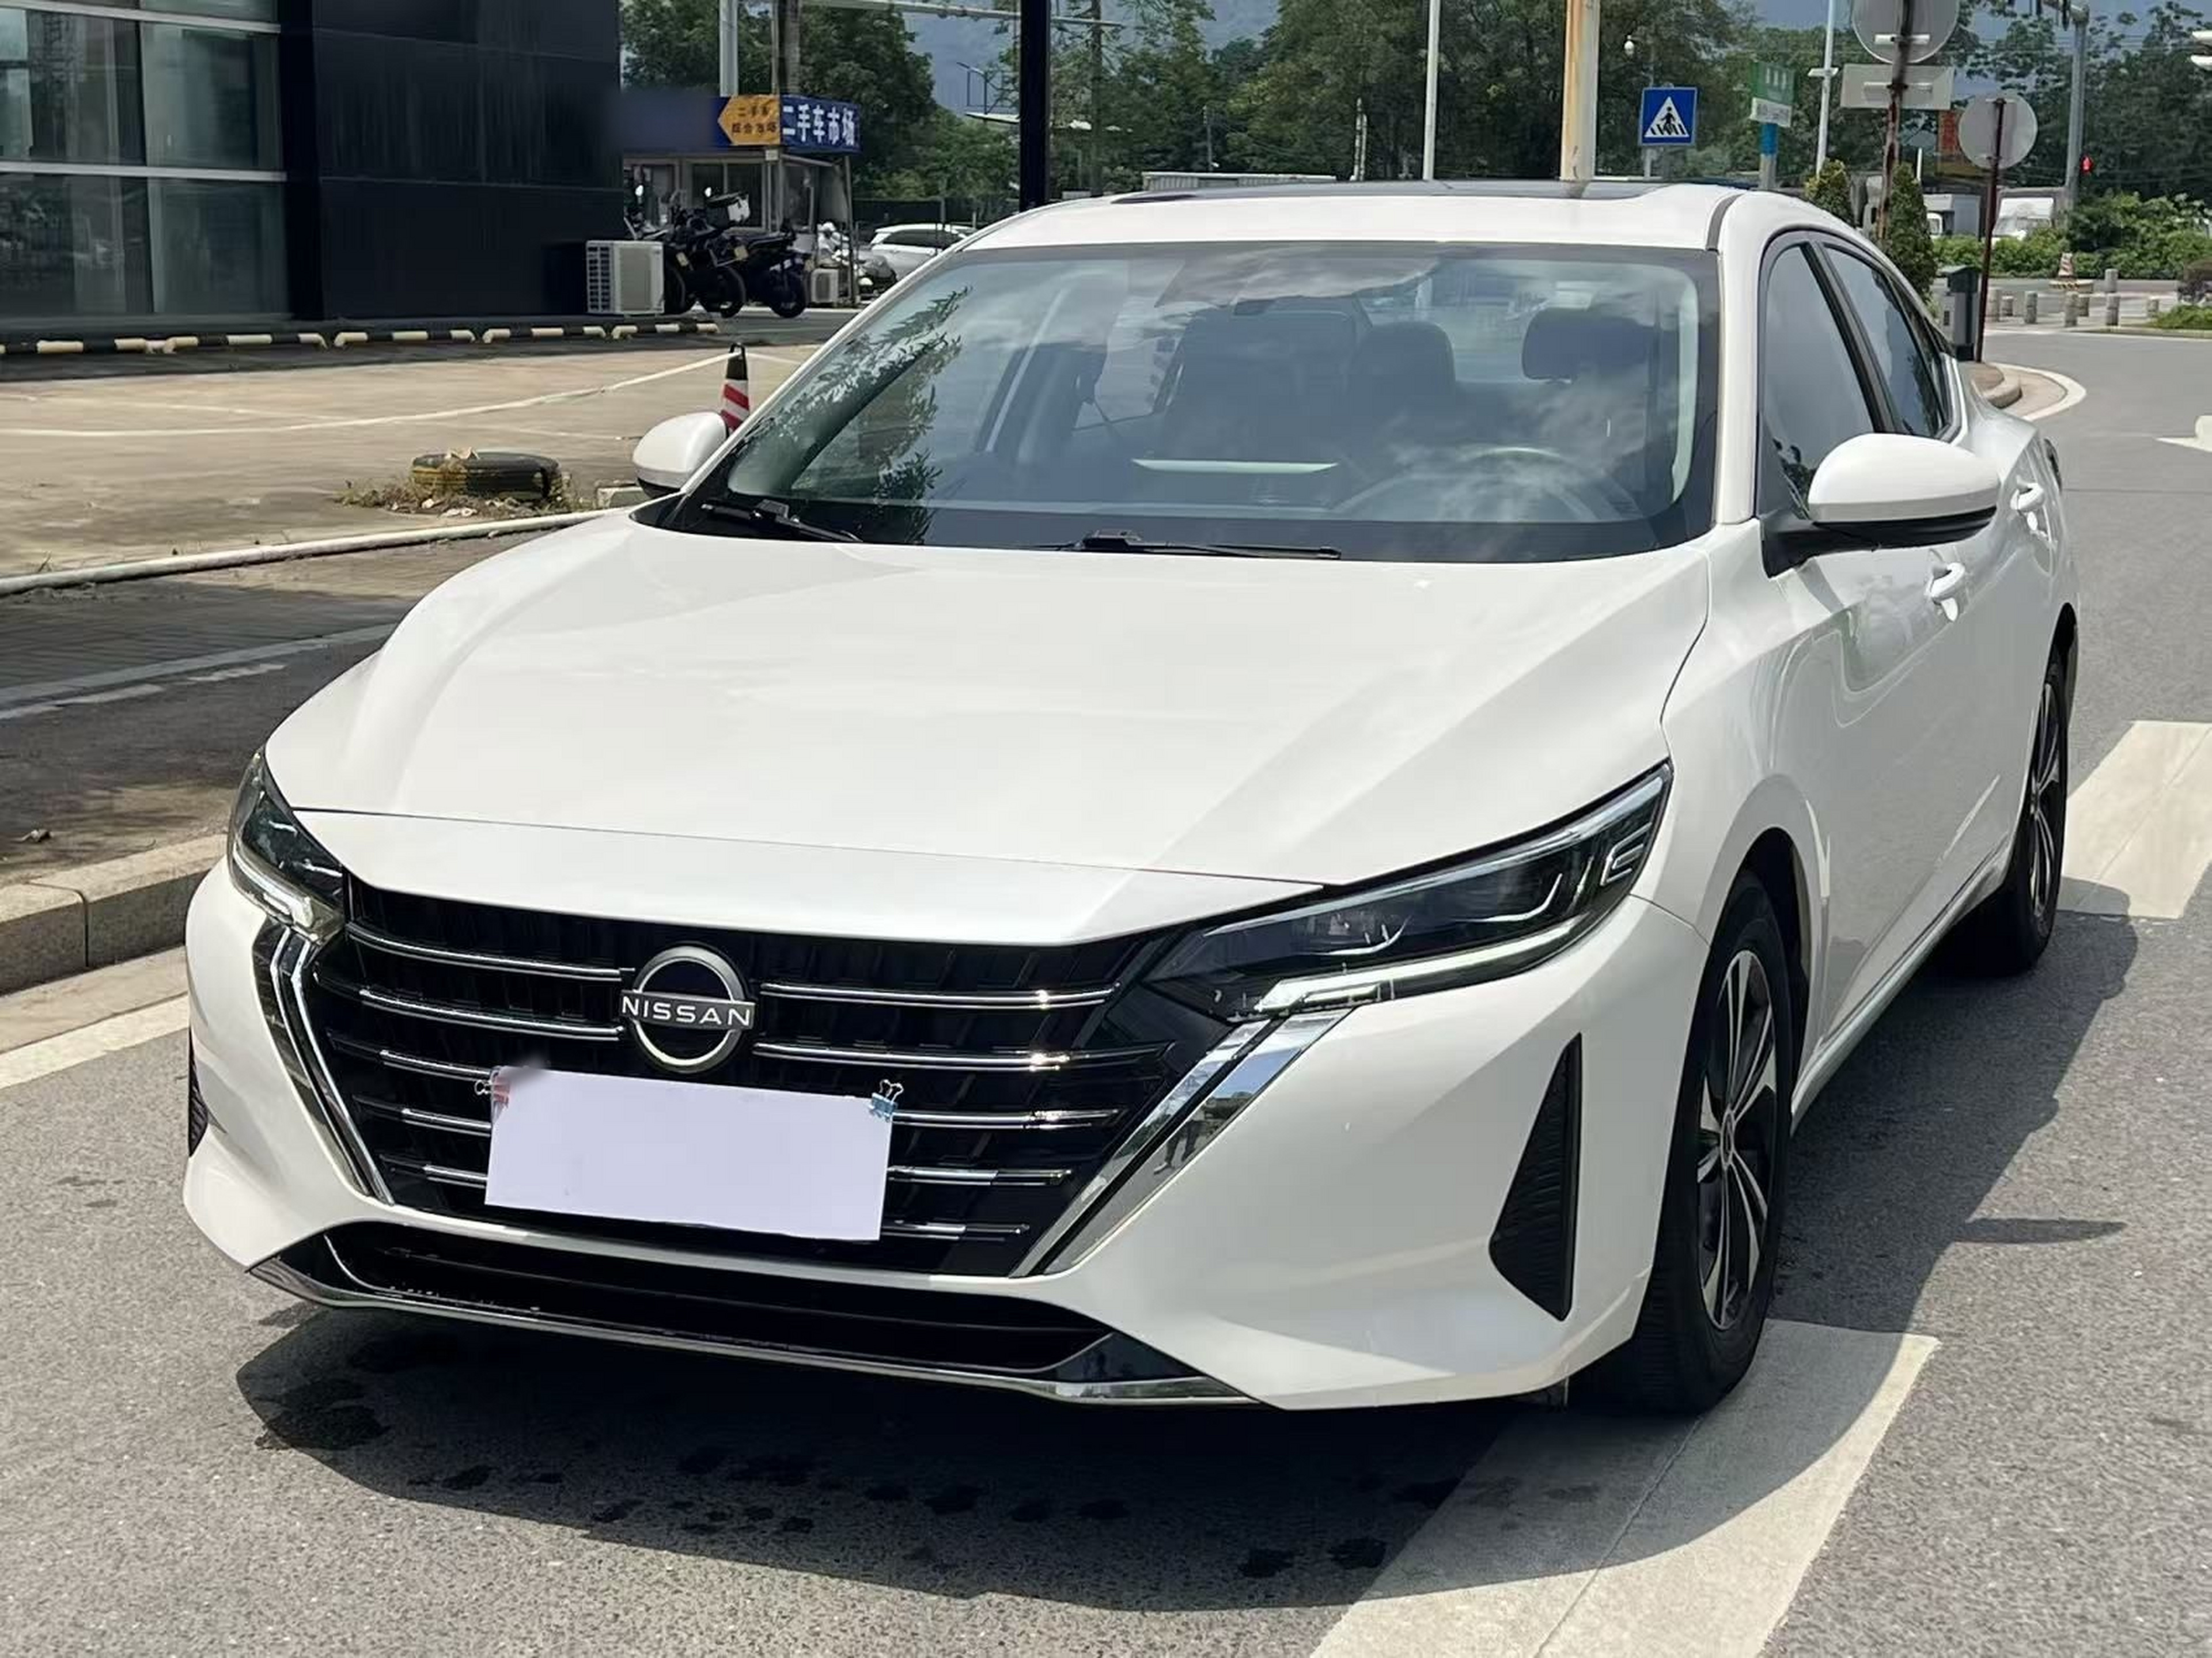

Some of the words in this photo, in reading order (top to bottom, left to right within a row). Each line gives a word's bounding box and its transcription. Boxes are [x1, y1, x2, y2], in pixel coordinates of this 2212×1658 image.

[782, 104, 854, 145] 二手车市场
[622, 996, 749, 1026] NISSAN
